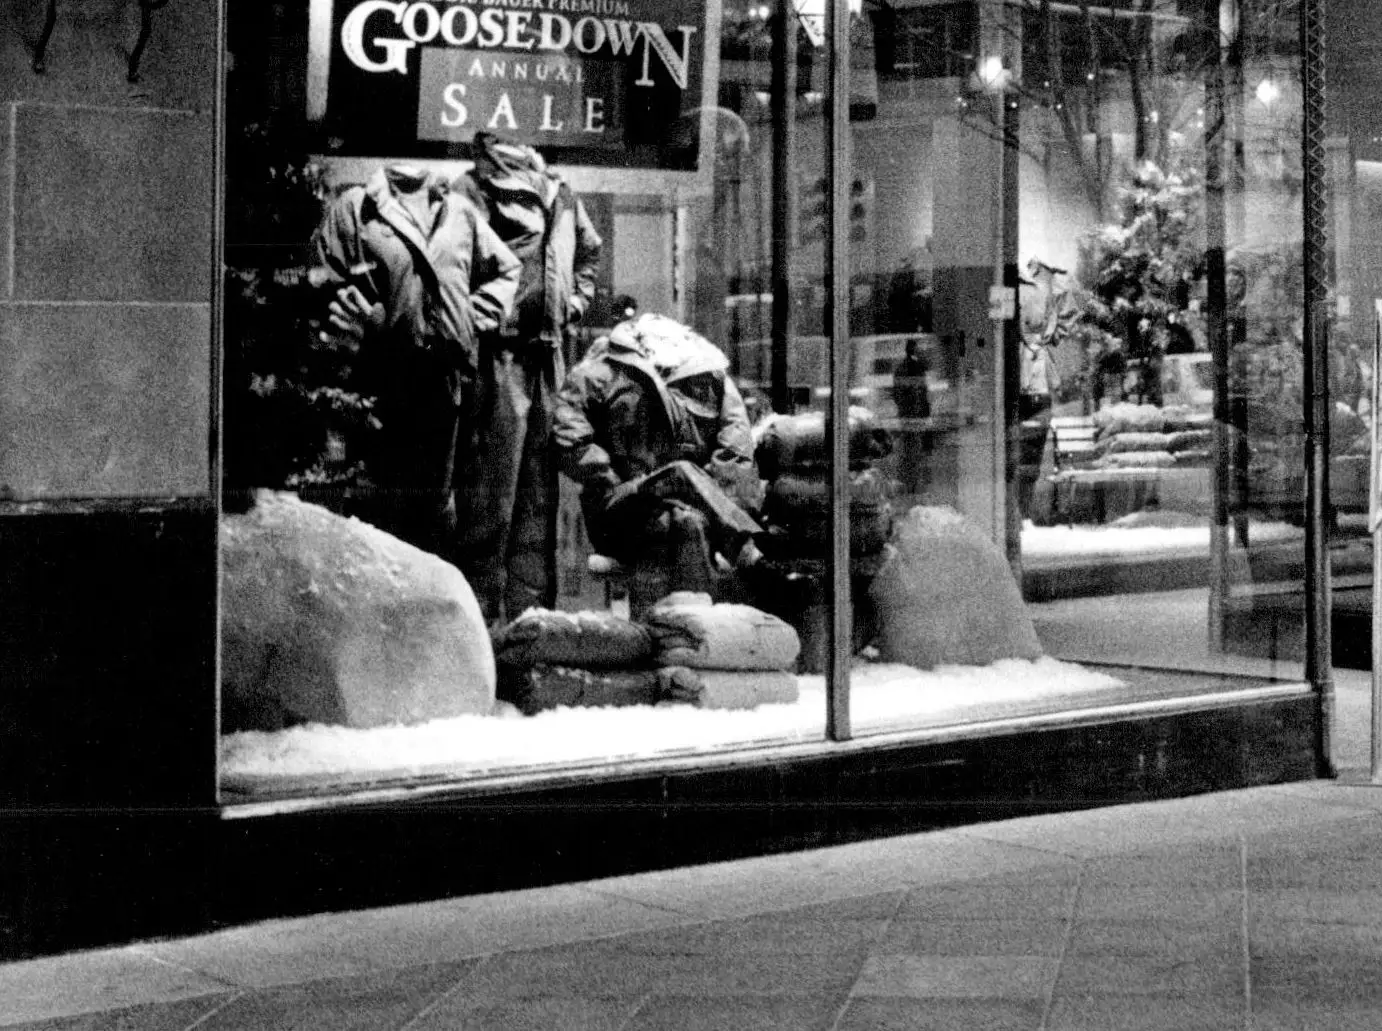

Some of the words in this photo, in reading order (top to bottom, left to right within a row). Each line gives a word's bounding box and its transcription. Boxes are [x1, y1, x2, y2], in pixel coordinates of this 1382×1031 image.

[341, 0, 697, 90] GOOSEDOWN
[467, 57, 584, 83] ANNUAL
[440, 83, 606, 133] SALE
